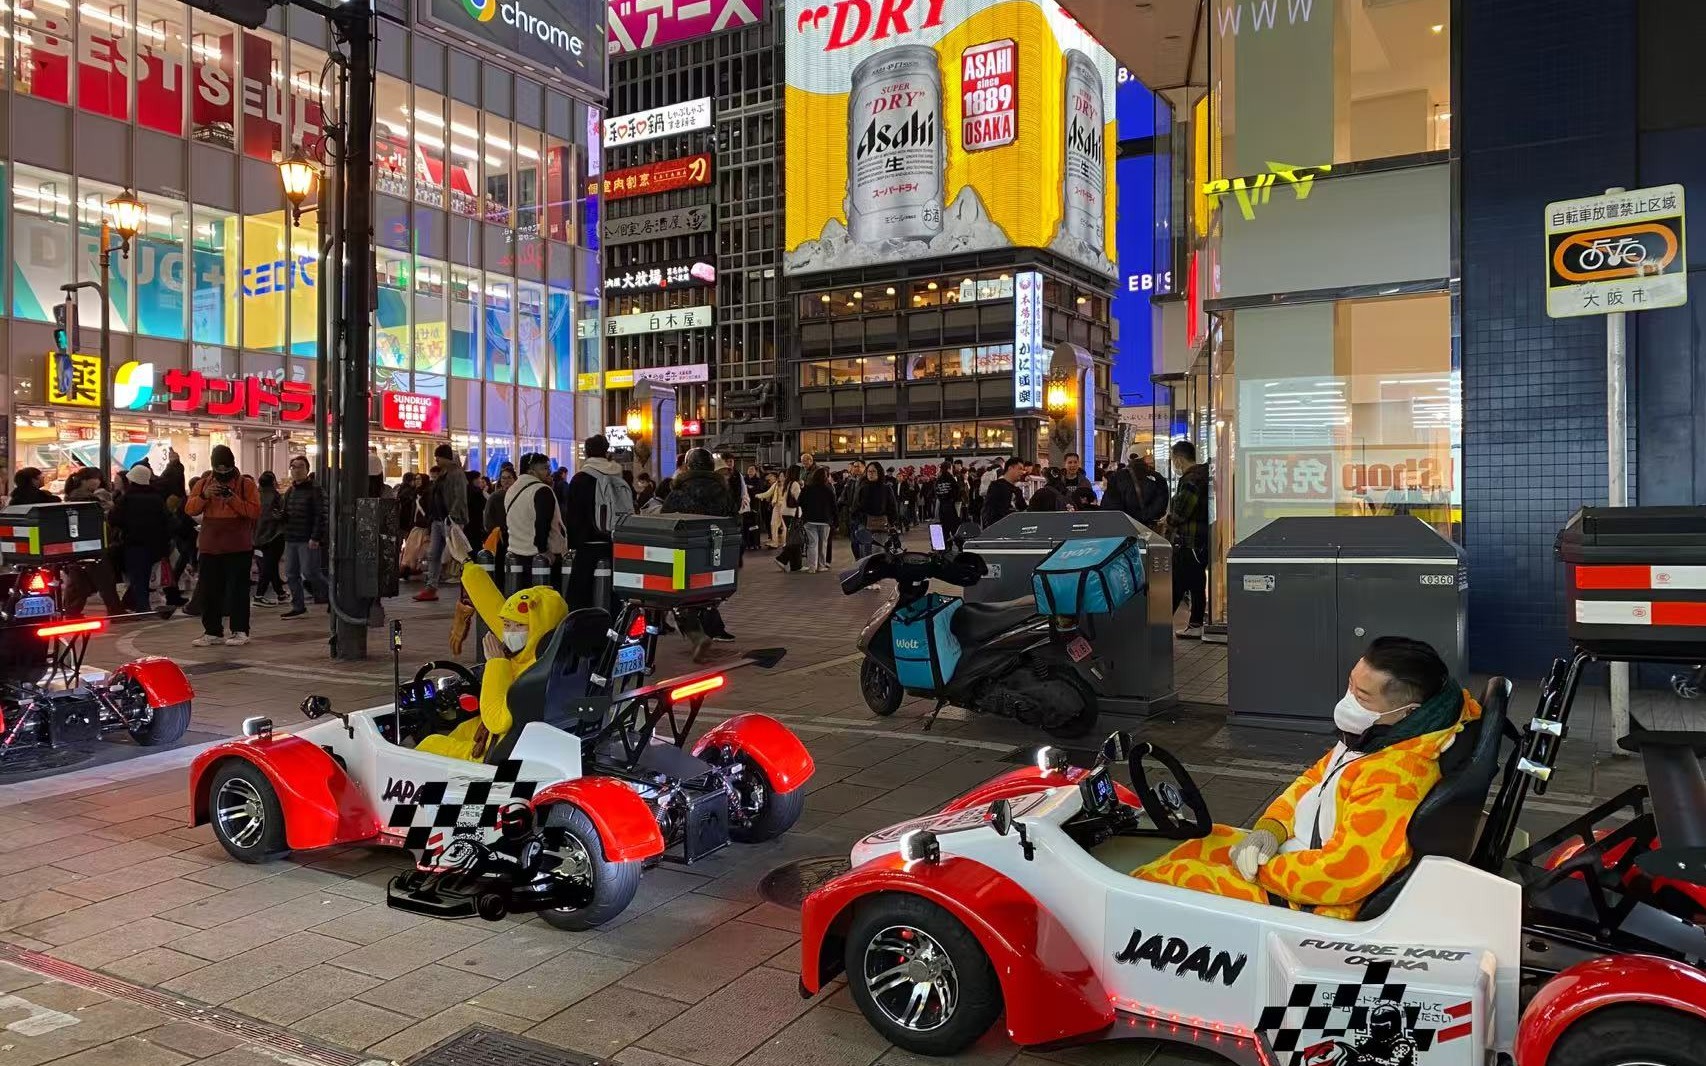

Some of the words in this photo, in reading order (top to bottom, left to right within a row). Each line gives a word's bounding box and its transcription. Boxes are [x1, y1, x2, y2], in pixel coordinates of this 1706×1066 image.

[501, 1, 582, 56] chrome
[964, 48, 1011, 81] ASAHI
[881, 82, 910, 95] SUPER
[977, 77, 999, 89] since
[964, 84, 1012, 117] 1889
[857, 109, 934, 160] Asahi
[964, 114, 1012, 145] OSAKA
[885, 156, 904, 173] 生
[872, 182, 919, 198] スーパードライ
[1552, 195, 1677, 227] 自転車放置禁止区域
[1583, 287, 1648, 309] 大阪市
[649, 311, 696, 332] 白木屋
[393, 393, 432, 407] SUNDRUG
[896, 638, 920, 650] Wolt
[1113, 926, 1248, 988] JAPAN
[1299, 938, 1400, 957] FUTURE
[1403, 947, 1472, 962] KART
